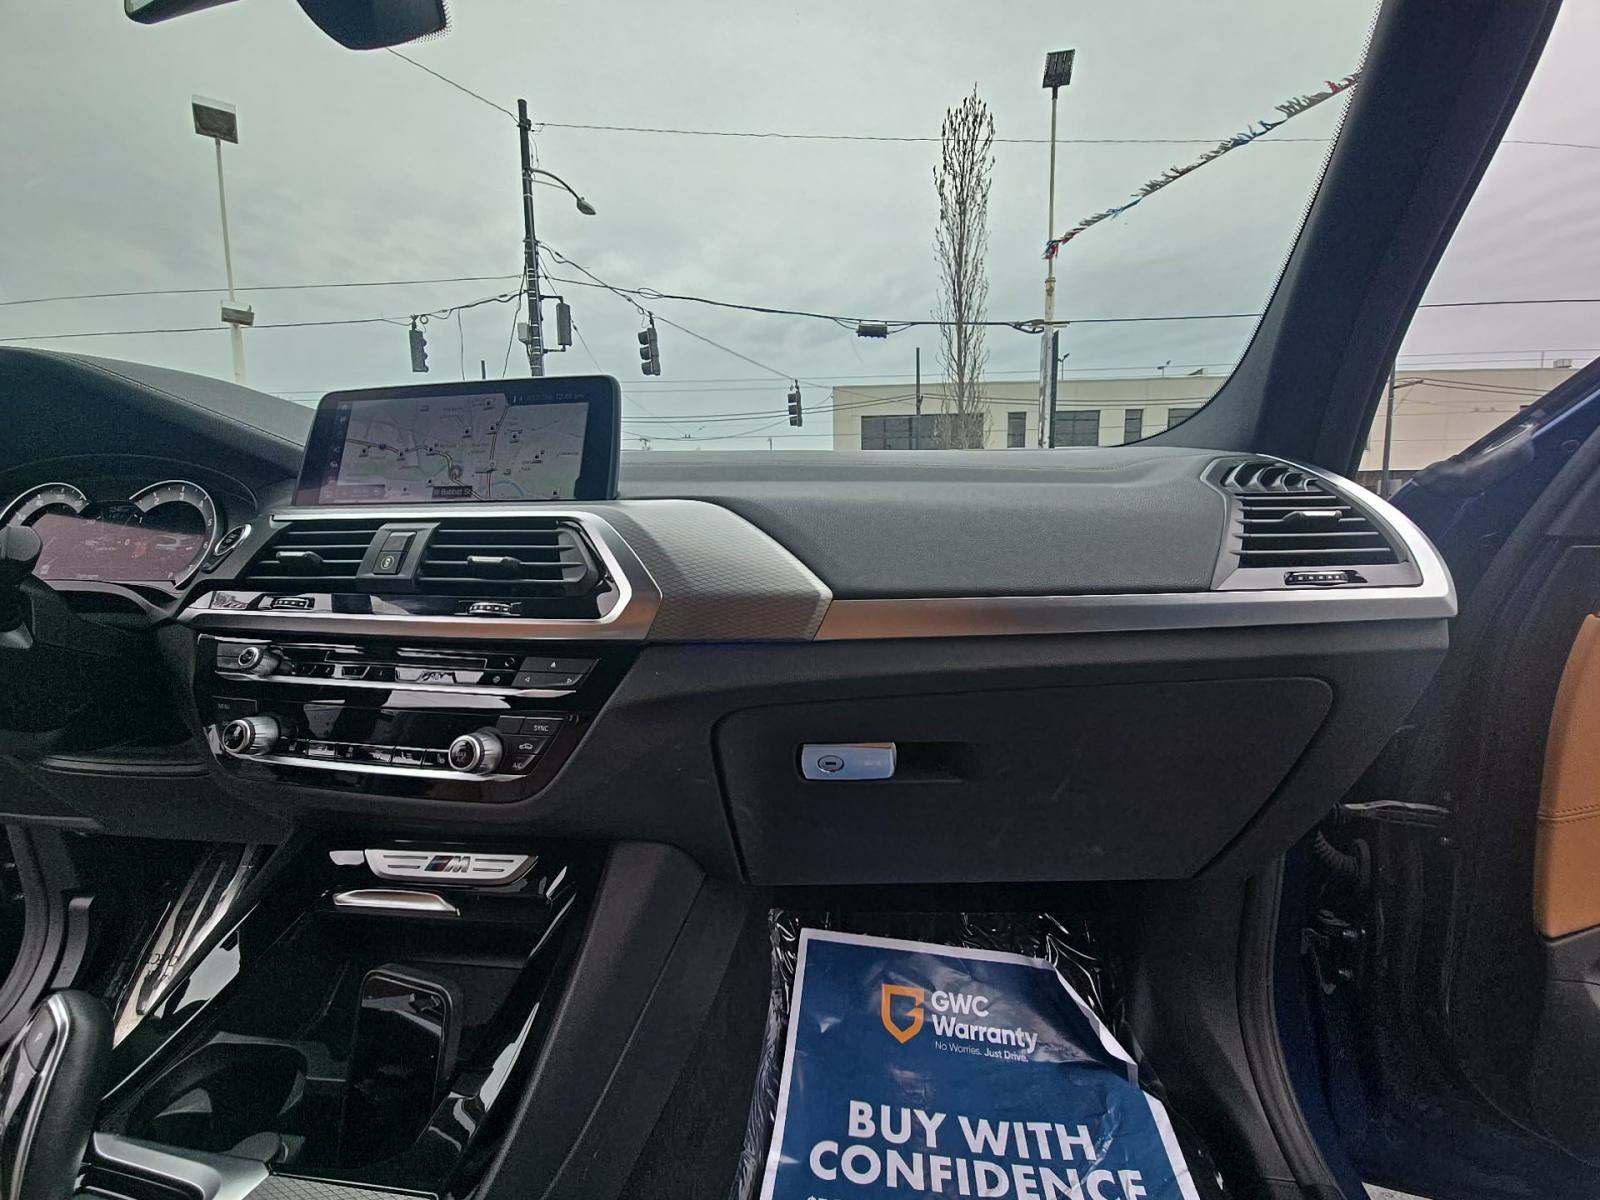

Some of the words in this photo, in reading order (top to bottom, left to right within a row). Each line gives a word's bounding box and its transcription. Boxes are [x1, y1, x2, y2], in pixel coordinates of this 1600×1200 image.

[533, 724, 549, 732] SYNC
[931, 990, 989, 1018] GWC
[931, 1014, 1038, 1054] Warranty
[935, 1040, 947, 1051] No
[949, 1042, 982, 1056] Worries.
[984, 1047, 1002, 1058] Just
[1004, 1050, 1029, 1063] Drive.
[848, 1100, 947, 1148] BUY
[957, 1115, 1097, 1161] WITH
[809, 1140, 1148, 1200] CONFIDENCE
